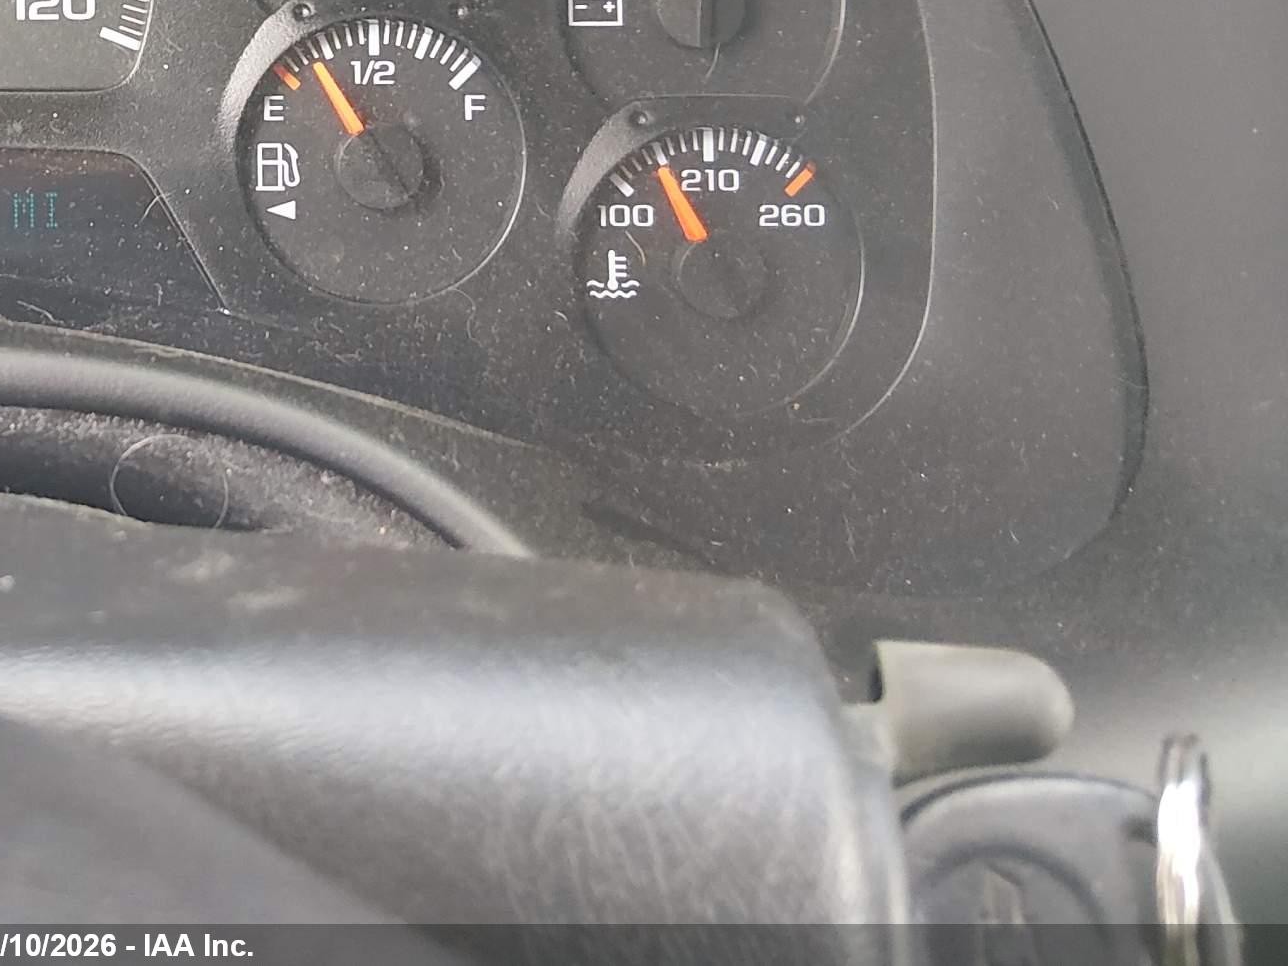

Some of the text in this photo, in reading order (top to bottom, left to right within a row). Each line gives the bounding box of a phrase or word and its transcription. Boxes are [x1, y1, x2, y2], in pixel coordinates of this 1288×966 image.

[350, 60, 396, 85] 1/2
[263, 95, 285, 121] E
[464, 94, 486, 121] F
[680, 169, 740, 193] 210
[14, 192, 58, 229] MI
[600, 204, 654, 227] 100
[759, 204, 826, 227] 260
